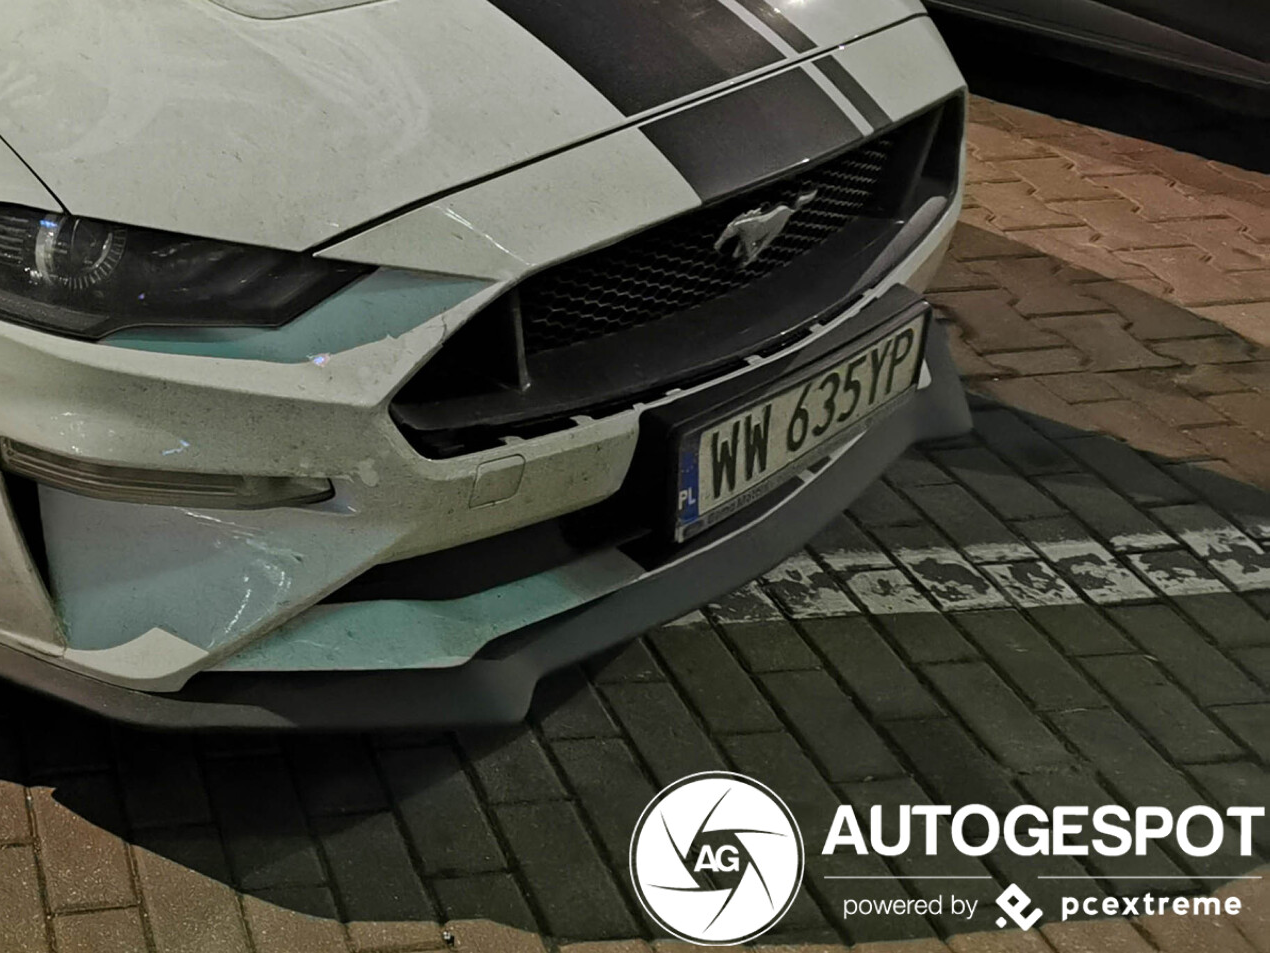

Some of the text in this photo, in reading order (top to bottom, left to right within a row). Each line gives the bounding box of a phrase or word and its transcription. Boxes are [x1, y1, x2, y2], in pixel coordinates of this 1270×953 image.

[710, 404, 772, 500] WW
[786, 327, 915, 453] 635YP
[678, 487, 696, 511] PL
